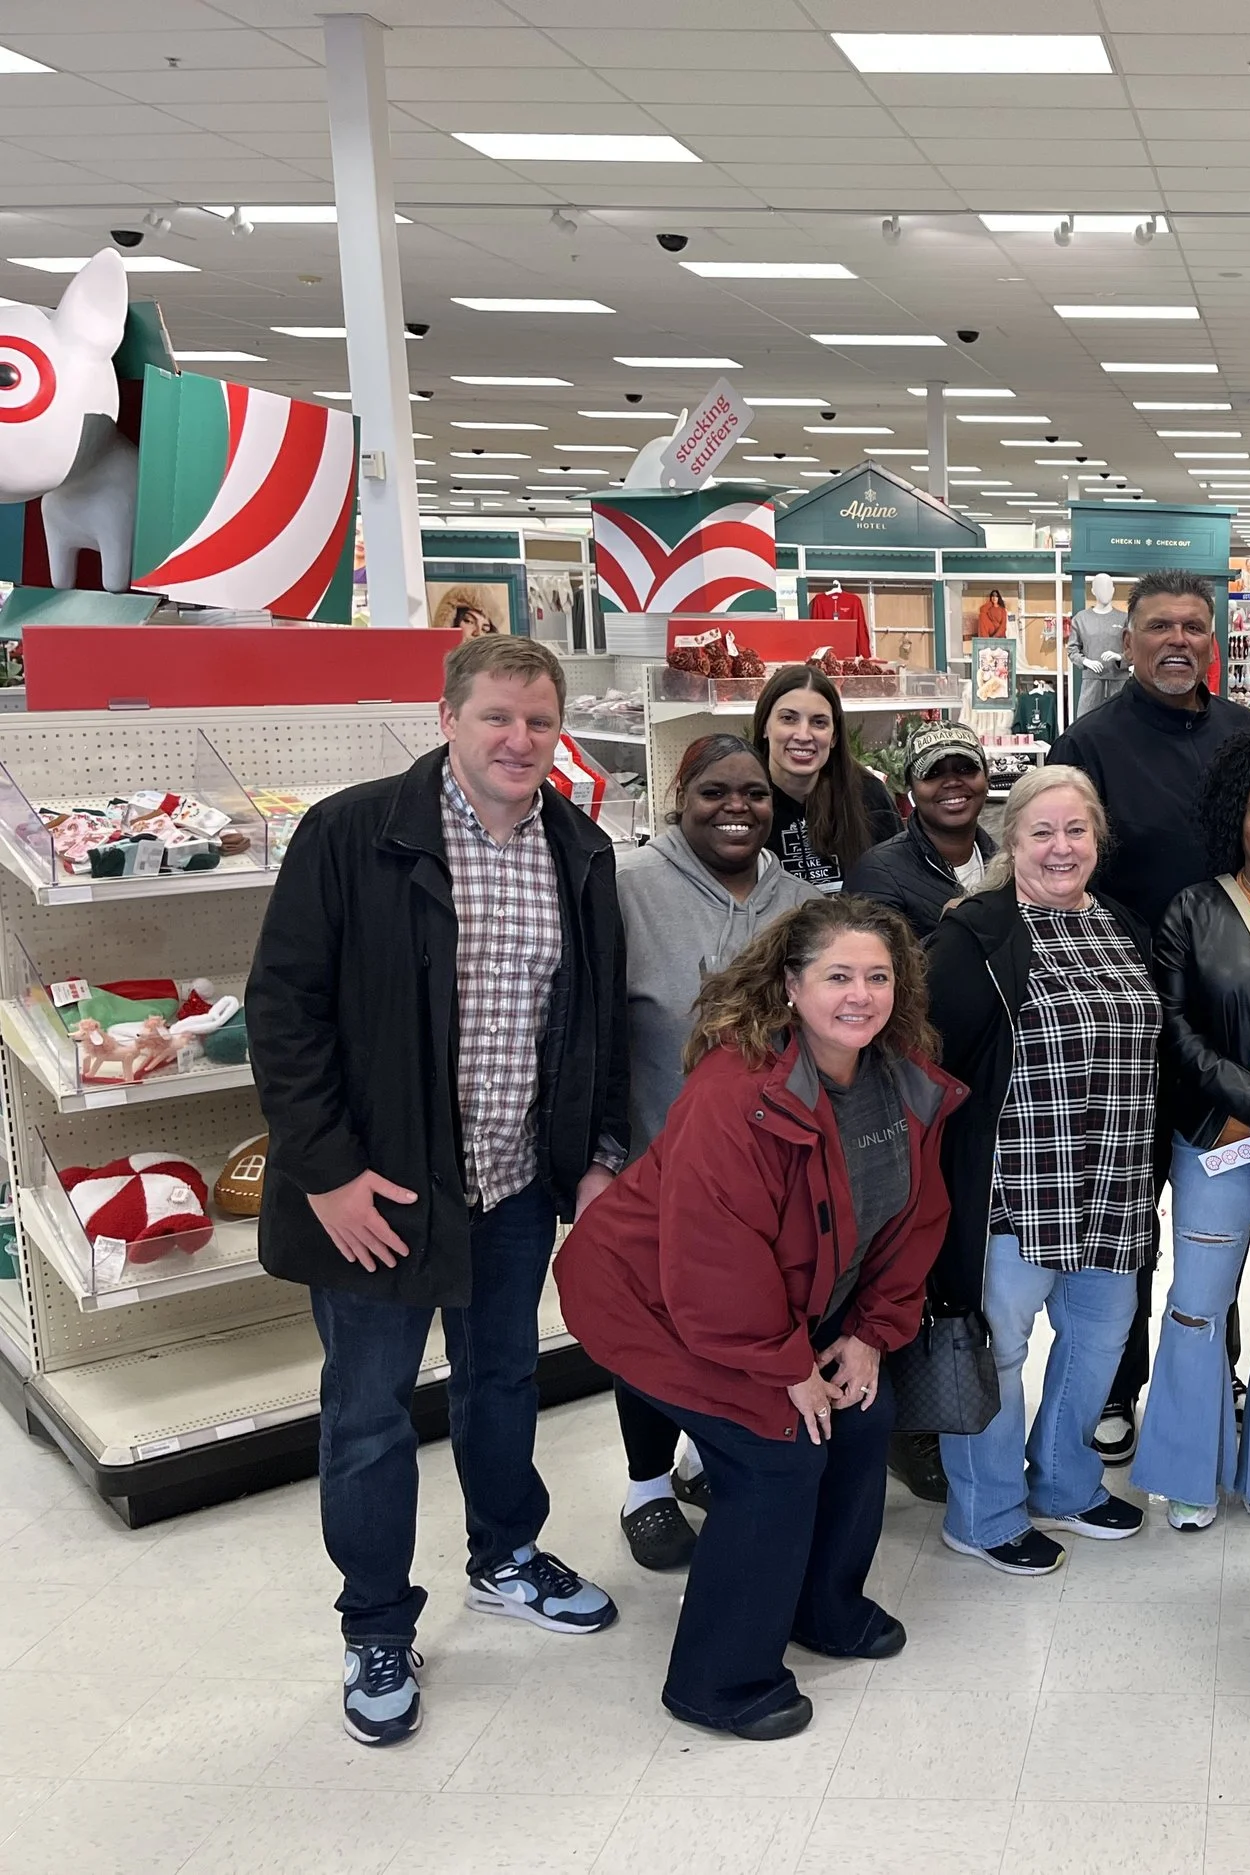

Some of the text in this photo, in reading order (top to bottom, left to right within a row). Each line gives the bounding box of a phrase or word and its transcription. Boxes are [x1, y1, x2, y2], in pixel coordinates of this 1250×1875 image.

[676, 394, 730, 463] stocking
[690, 413, 738, 475] stuffers
[840, 500, 898, 521] Alpine
[856, 522, 887, 530] HOTEL
[916, 735, 933, 749] BAD
[934, 730, 953, 743] HAIR
[794, 868, 829, 879] CLSSIC
